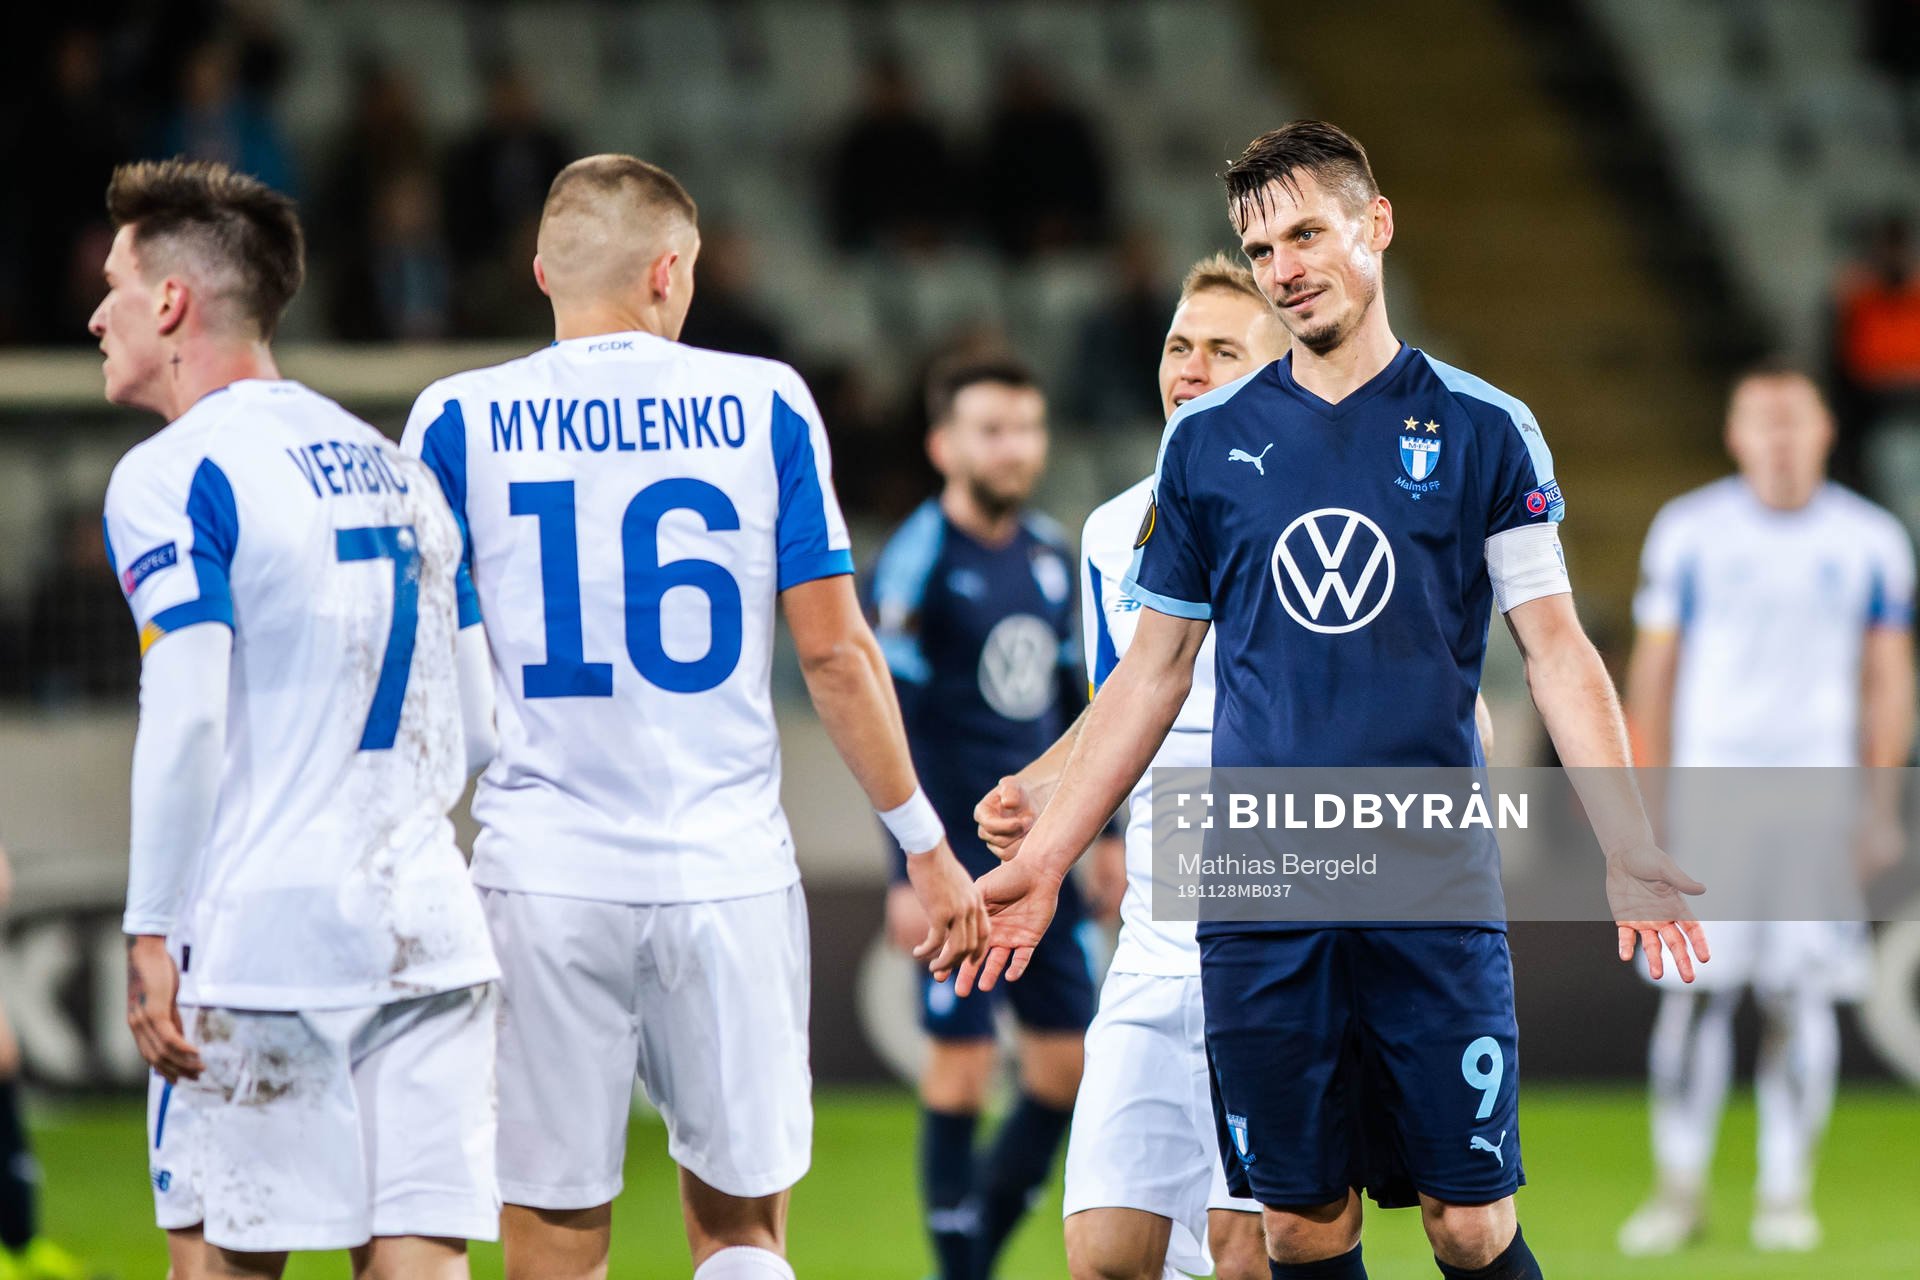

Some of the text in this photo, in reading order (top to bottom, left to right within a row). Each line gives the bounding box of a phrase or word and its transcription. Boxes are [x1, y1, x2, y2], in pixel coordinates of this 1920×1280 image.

[588, 341, 634, 352] FCDK
[490, 394, 746, 453] MYKOLENKO
[286, 441, 408, 498] VERBIC
[1394, 476, 1441, 492] Malmö FF
[508, 477, 743, 699] 16
[335, 525, 422, 751] 7
[1461, 1036, 1504, 1119] 9
